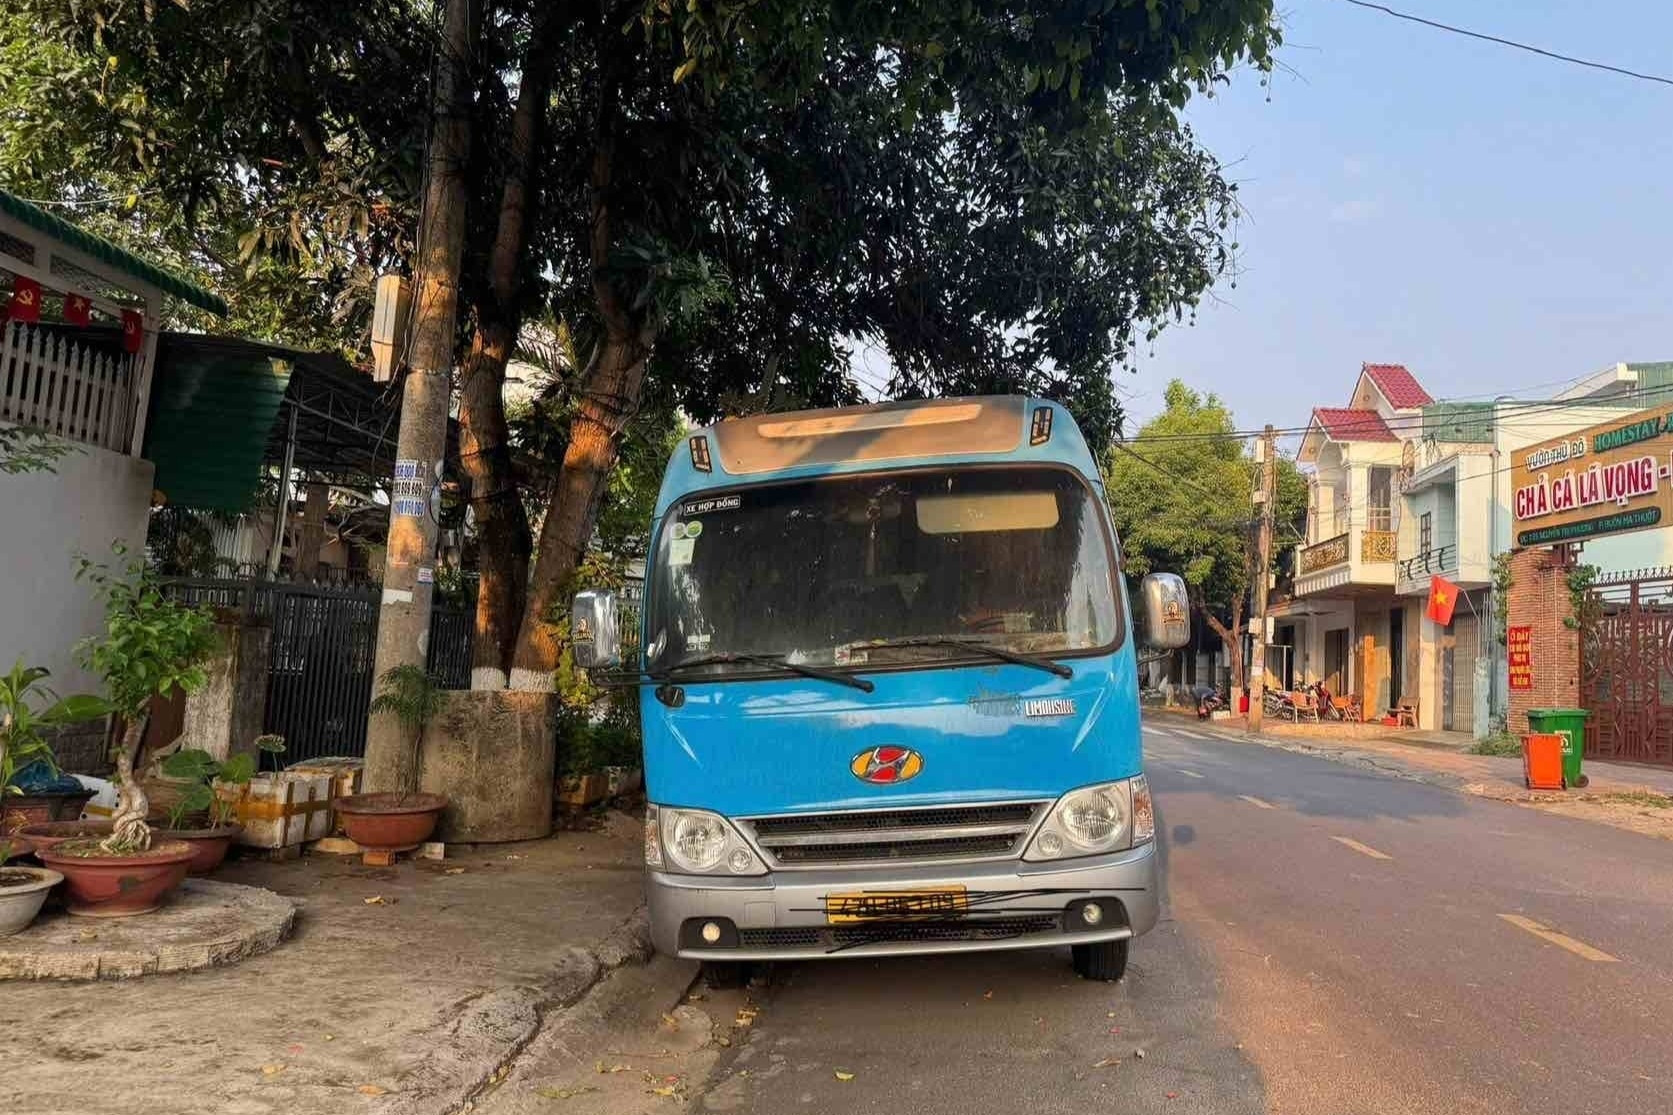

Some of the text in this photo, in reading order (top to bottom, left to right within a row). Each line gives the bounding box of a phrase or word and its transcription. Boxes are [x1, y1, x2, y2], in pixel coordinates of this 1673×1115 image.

[1594, 416, 1659, 452] HOMESTAY
[1516, 473, 1548, 519] CHẢ
[1552, 471, 1574, 511] CÁ
[1579, 464, 1599, 504] LÃ
[1603, 457, 1654, 503] VỌNG
[686, 504, 696, 514] XE
